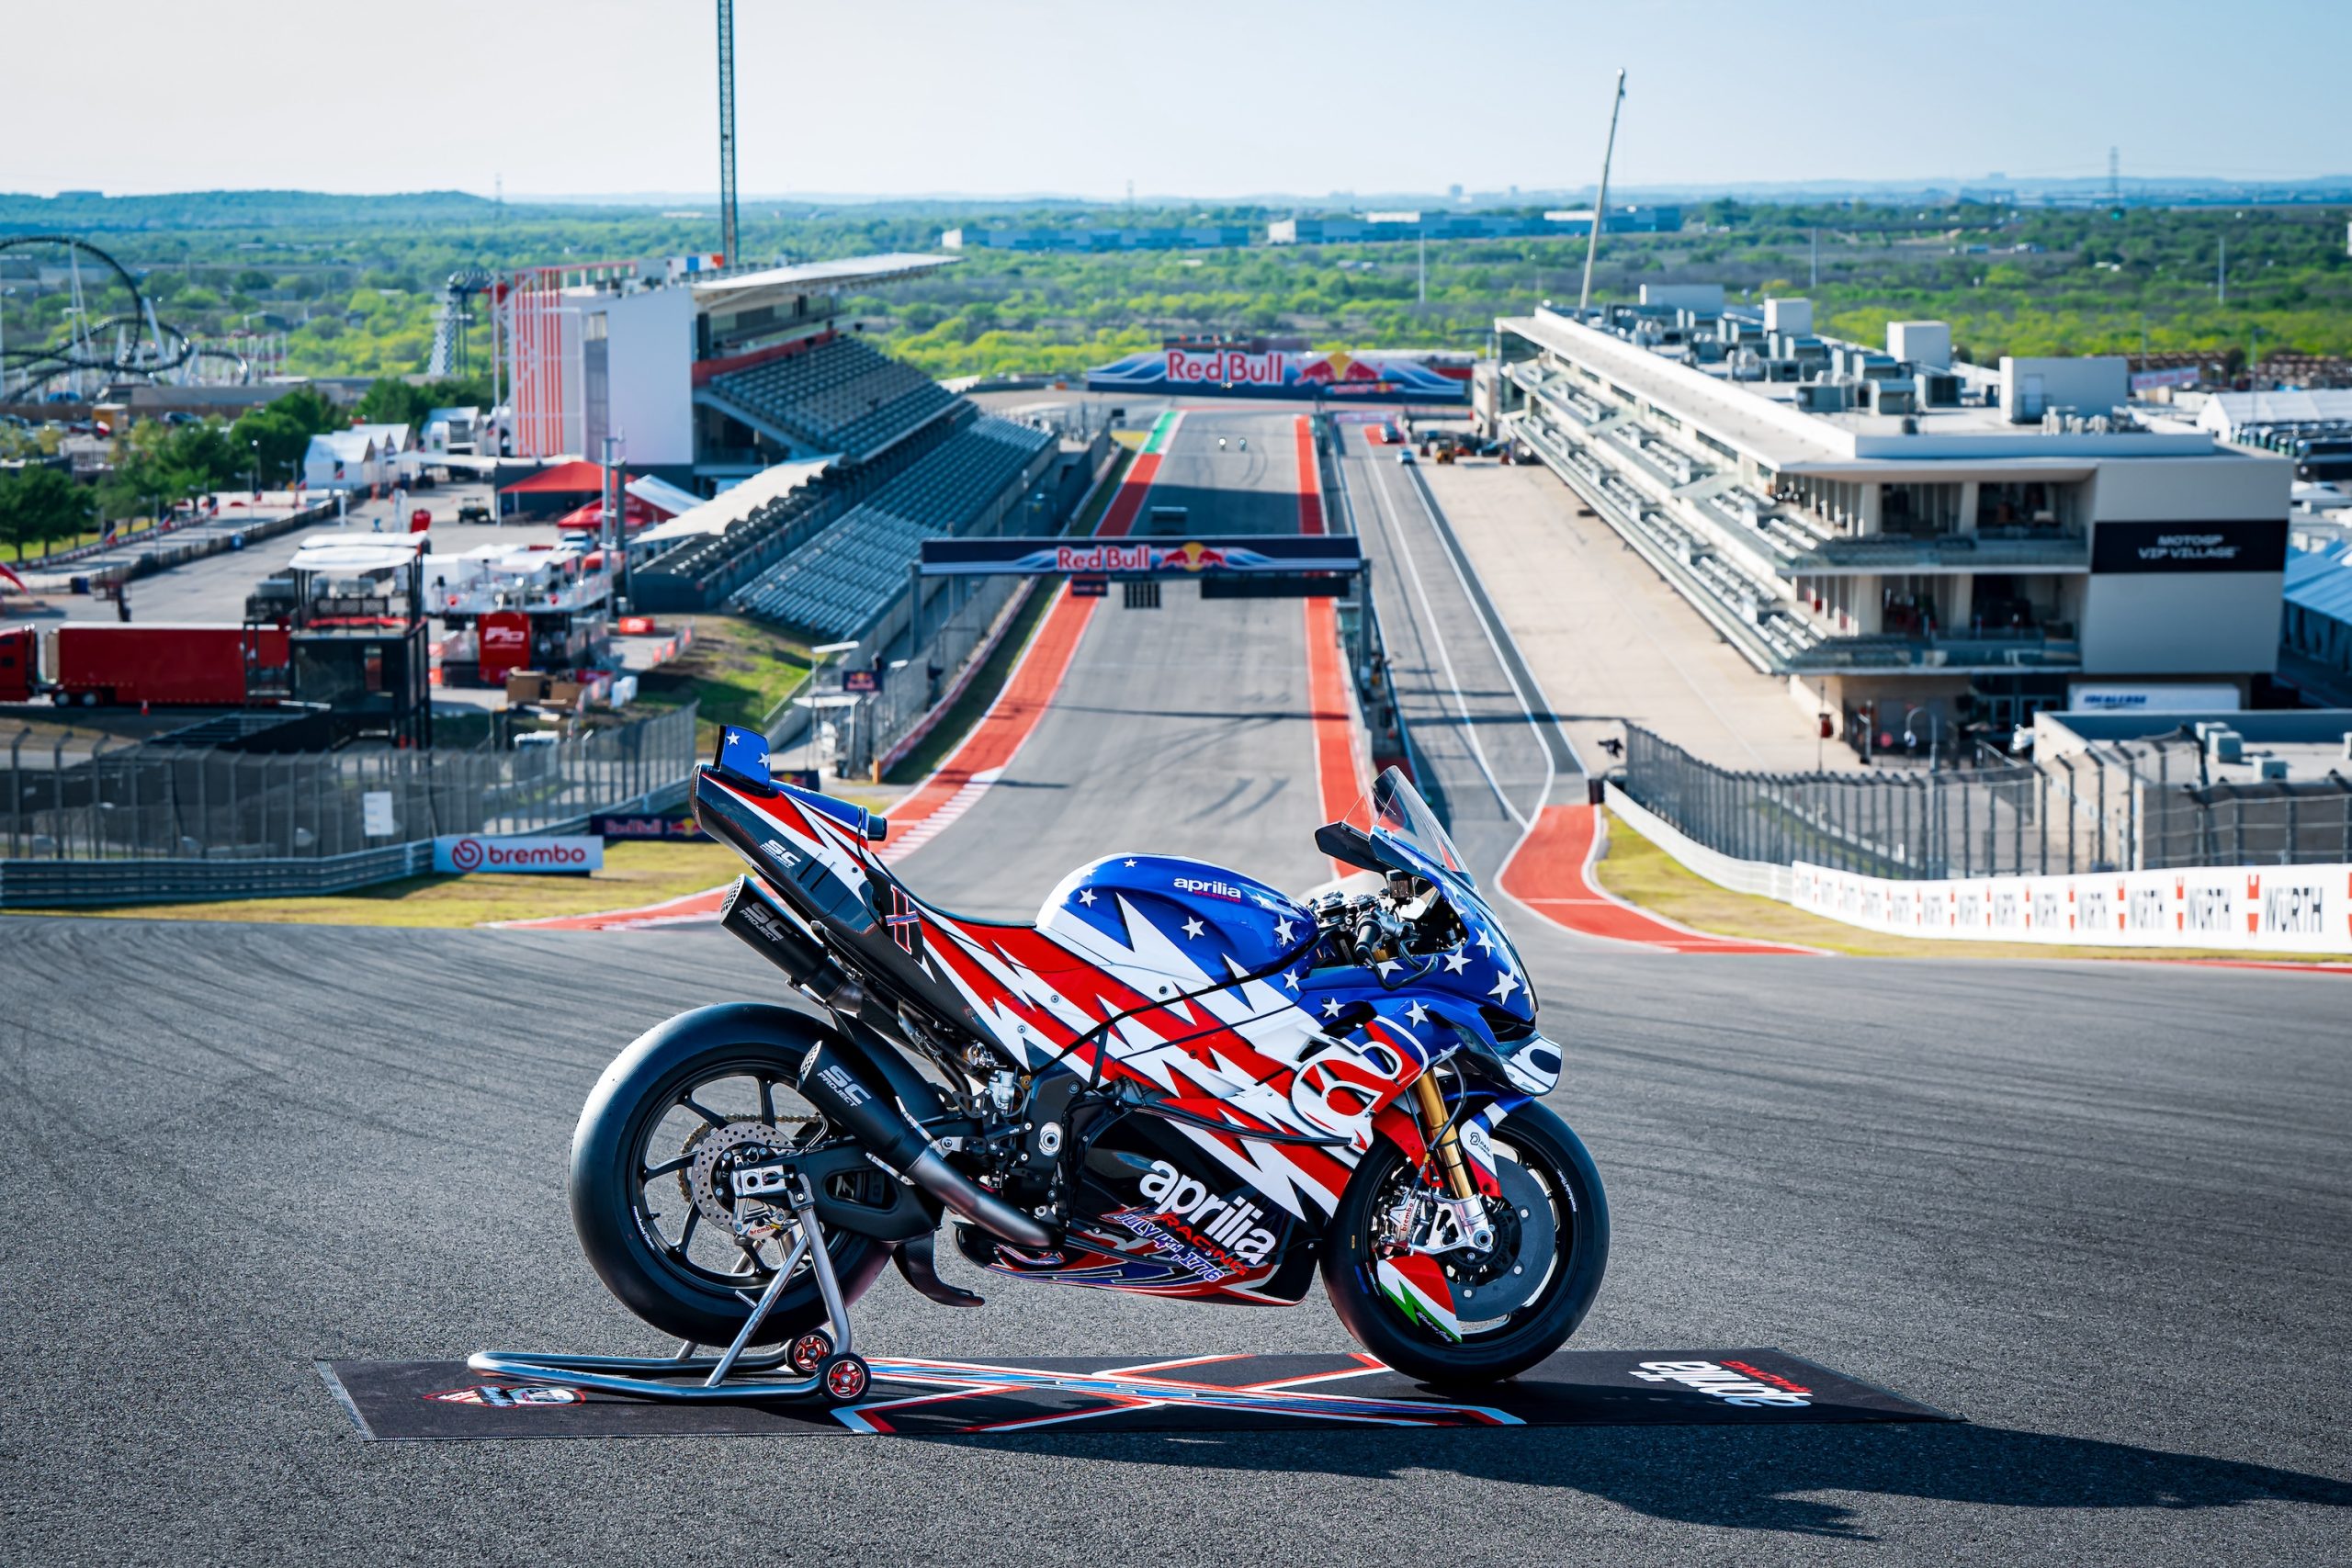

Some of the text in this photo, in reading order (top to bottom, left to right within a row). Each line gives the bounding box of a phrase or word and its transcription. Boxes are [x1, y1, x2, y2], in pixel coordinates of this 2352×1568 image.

[1167, 349, 1284, 385] Red Bull
[1057, 545, 1149, 569] Red Bull
[2138, 547, 2235, 559] VIP VILLAGE
[488, 844, 586, 864] brembo
[762, 839, 802, 866] SC
[1173, 877, 1241, 899] aprilia
[740, 909, 779, 942] PROJECT
[743, 901, 792, 941] SC
[817, 1072, 858, 1107] PROJECT
[822, 1065, 872, 1105] SC
[1114, 1213, 1162, 1238] JULY
[1139, 1159, 1276, 1266] aprilia
[1400, 1202, 1415, 1232] brembo
[1160, 1211, 1250, 1277] RACING
[1628, 1360, 1814, 1407] aprilia
